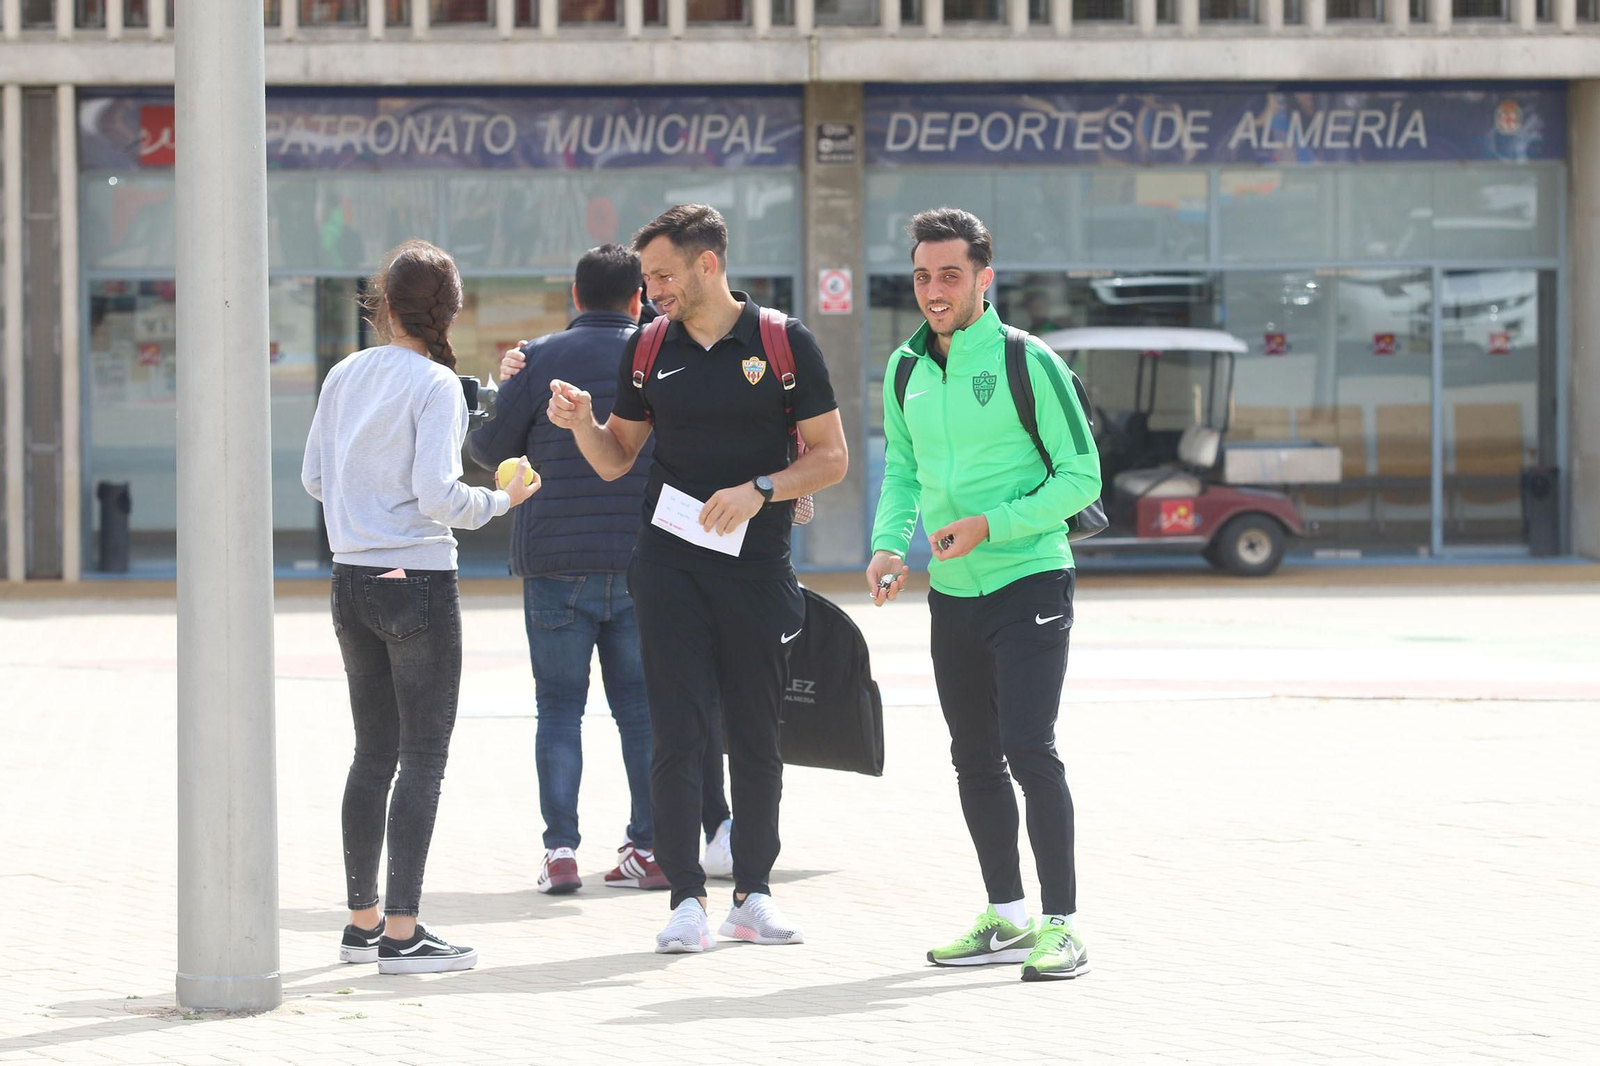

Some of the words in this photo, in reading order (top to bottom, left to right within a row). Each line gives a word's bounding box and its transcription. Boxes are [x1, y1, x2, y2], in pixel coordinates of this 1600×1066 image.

[267, 114, 517, 155] PATRONATO
[543, 113, 778, 155] MUNICIPAL
[885, 110, 1135, 152] DEPORTES
[1151, 110, 1213, 151] DE
[1228, 100, 1428, 150] ALMERÍA
